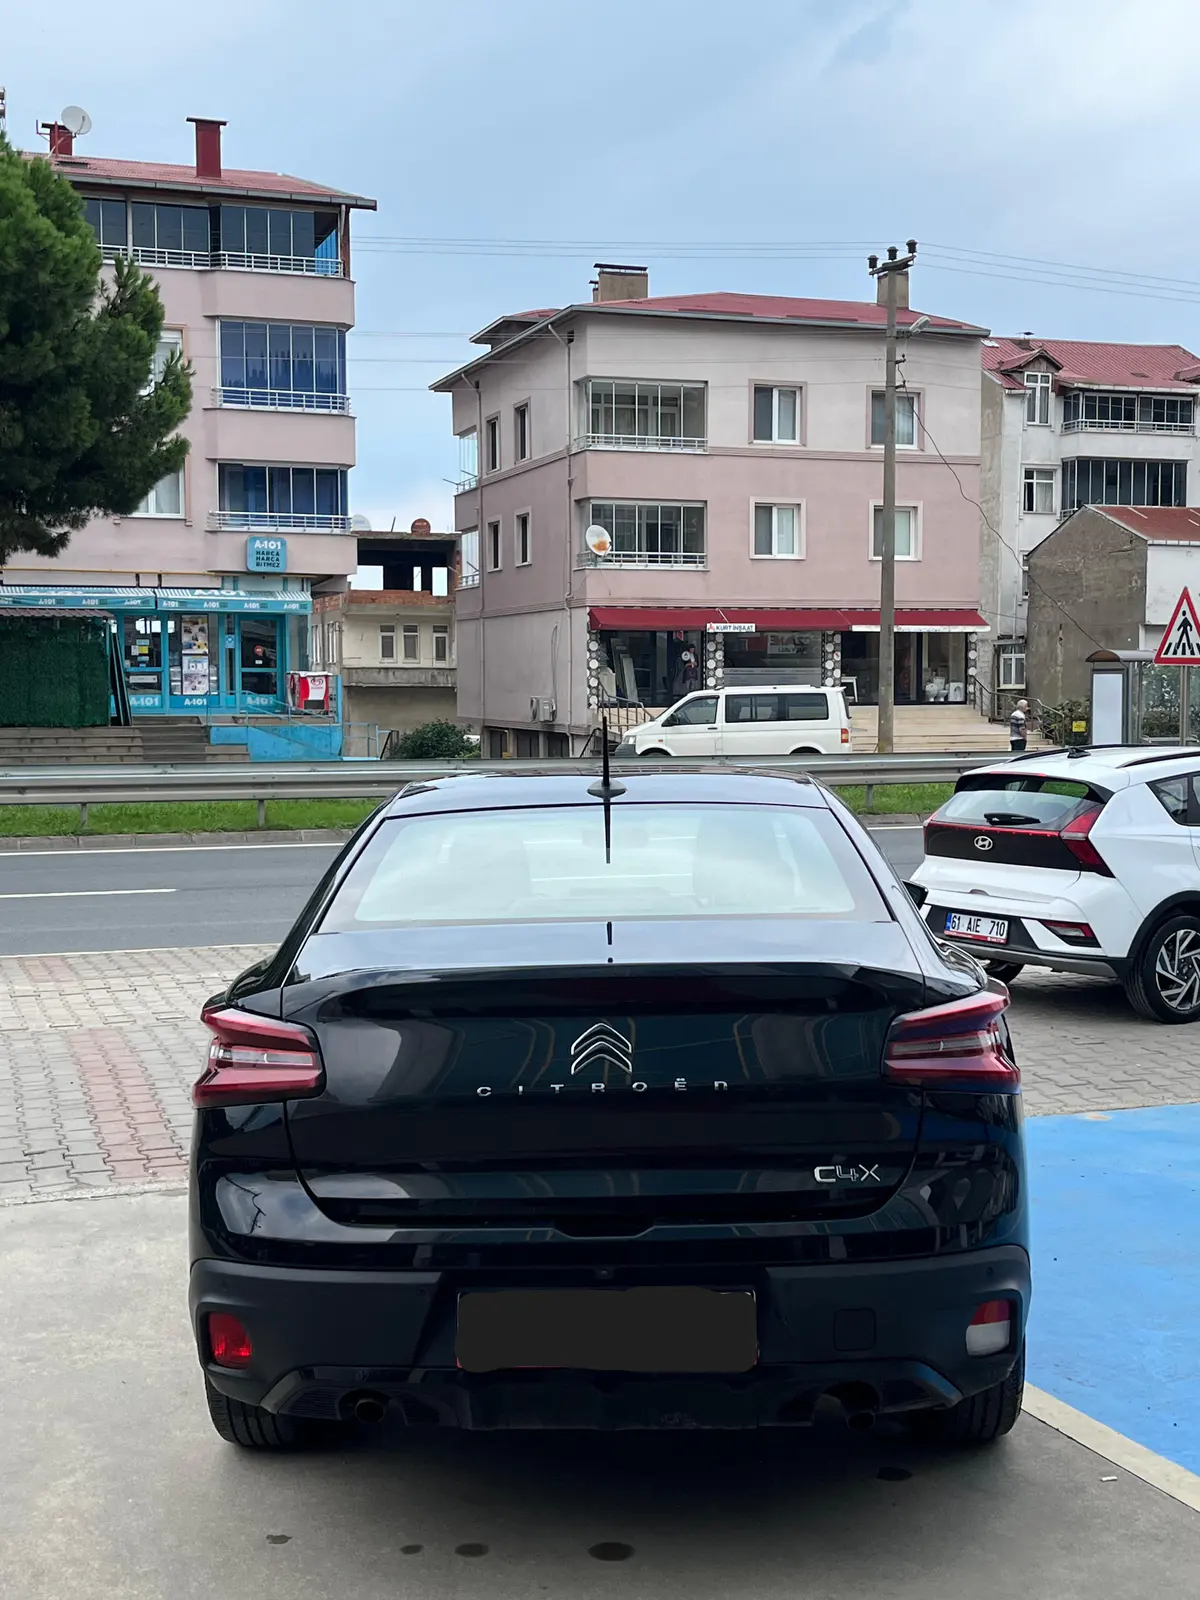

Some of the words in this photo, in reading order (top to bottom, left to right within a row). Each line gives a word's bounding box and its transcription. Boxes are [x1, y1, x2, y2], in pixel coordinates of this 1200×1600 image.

[951, 914, 961, 931] 61
[966, 917, 982, 934] AIE
[988, 920, 1006, 937] 710
